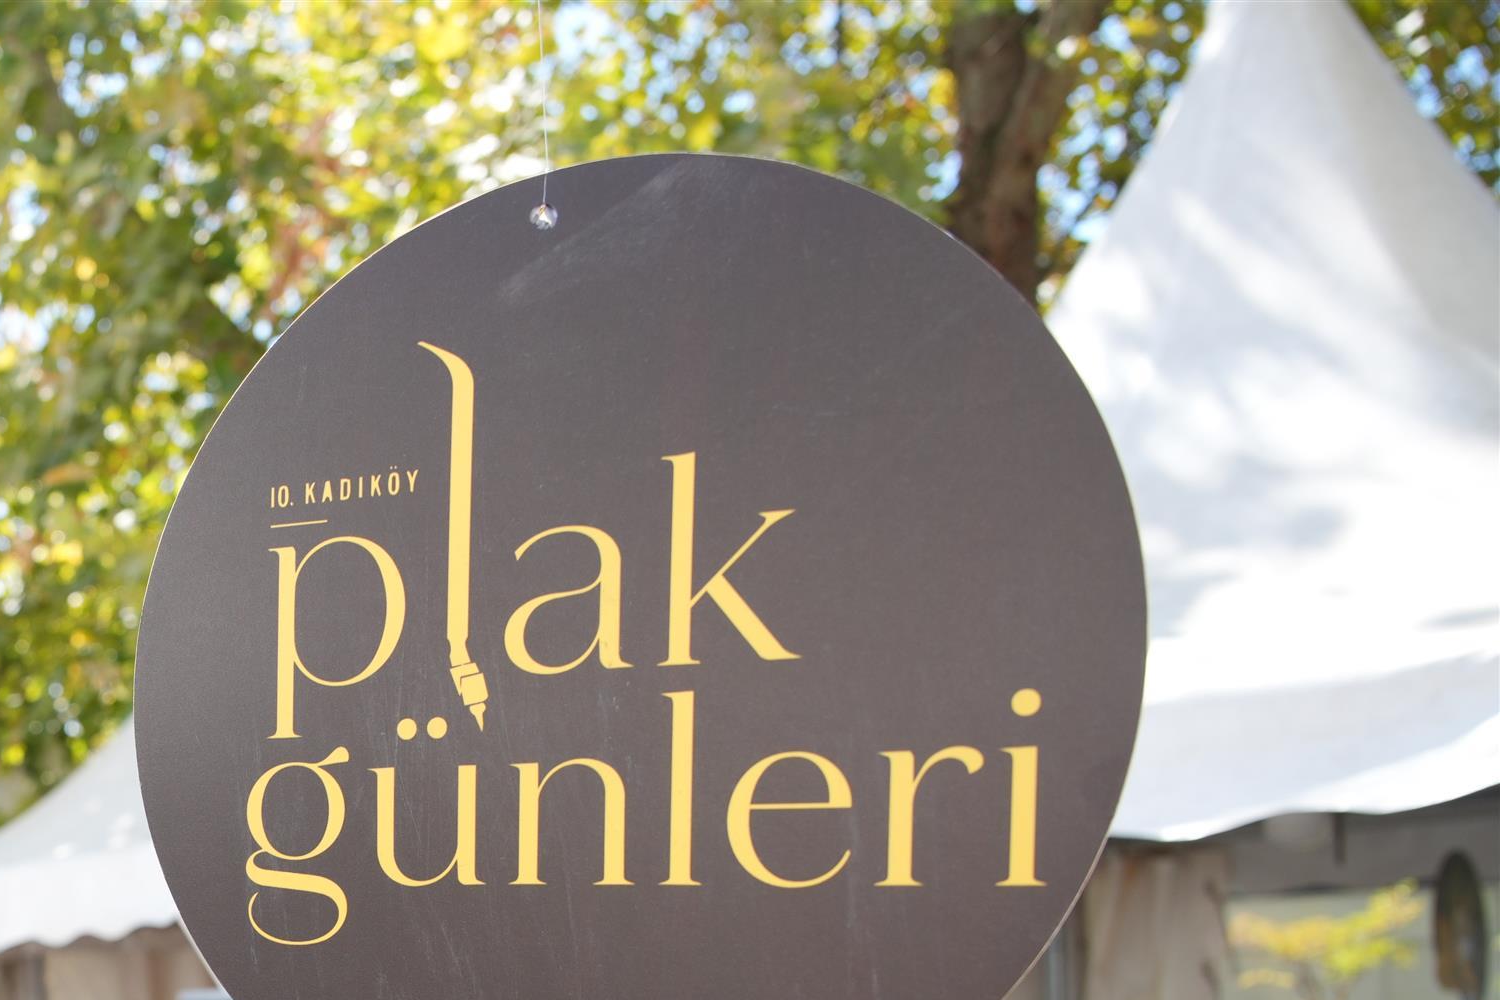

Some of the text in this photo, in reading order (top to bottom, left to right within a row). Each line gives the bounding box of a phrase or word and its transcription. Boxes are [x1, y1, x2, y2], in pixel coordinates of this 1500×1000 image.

[267, 339, 803, 741] plak
[270, 465, 419, 508] 10. KADIKÖY
[244, 687, 1048, 948] günleri
